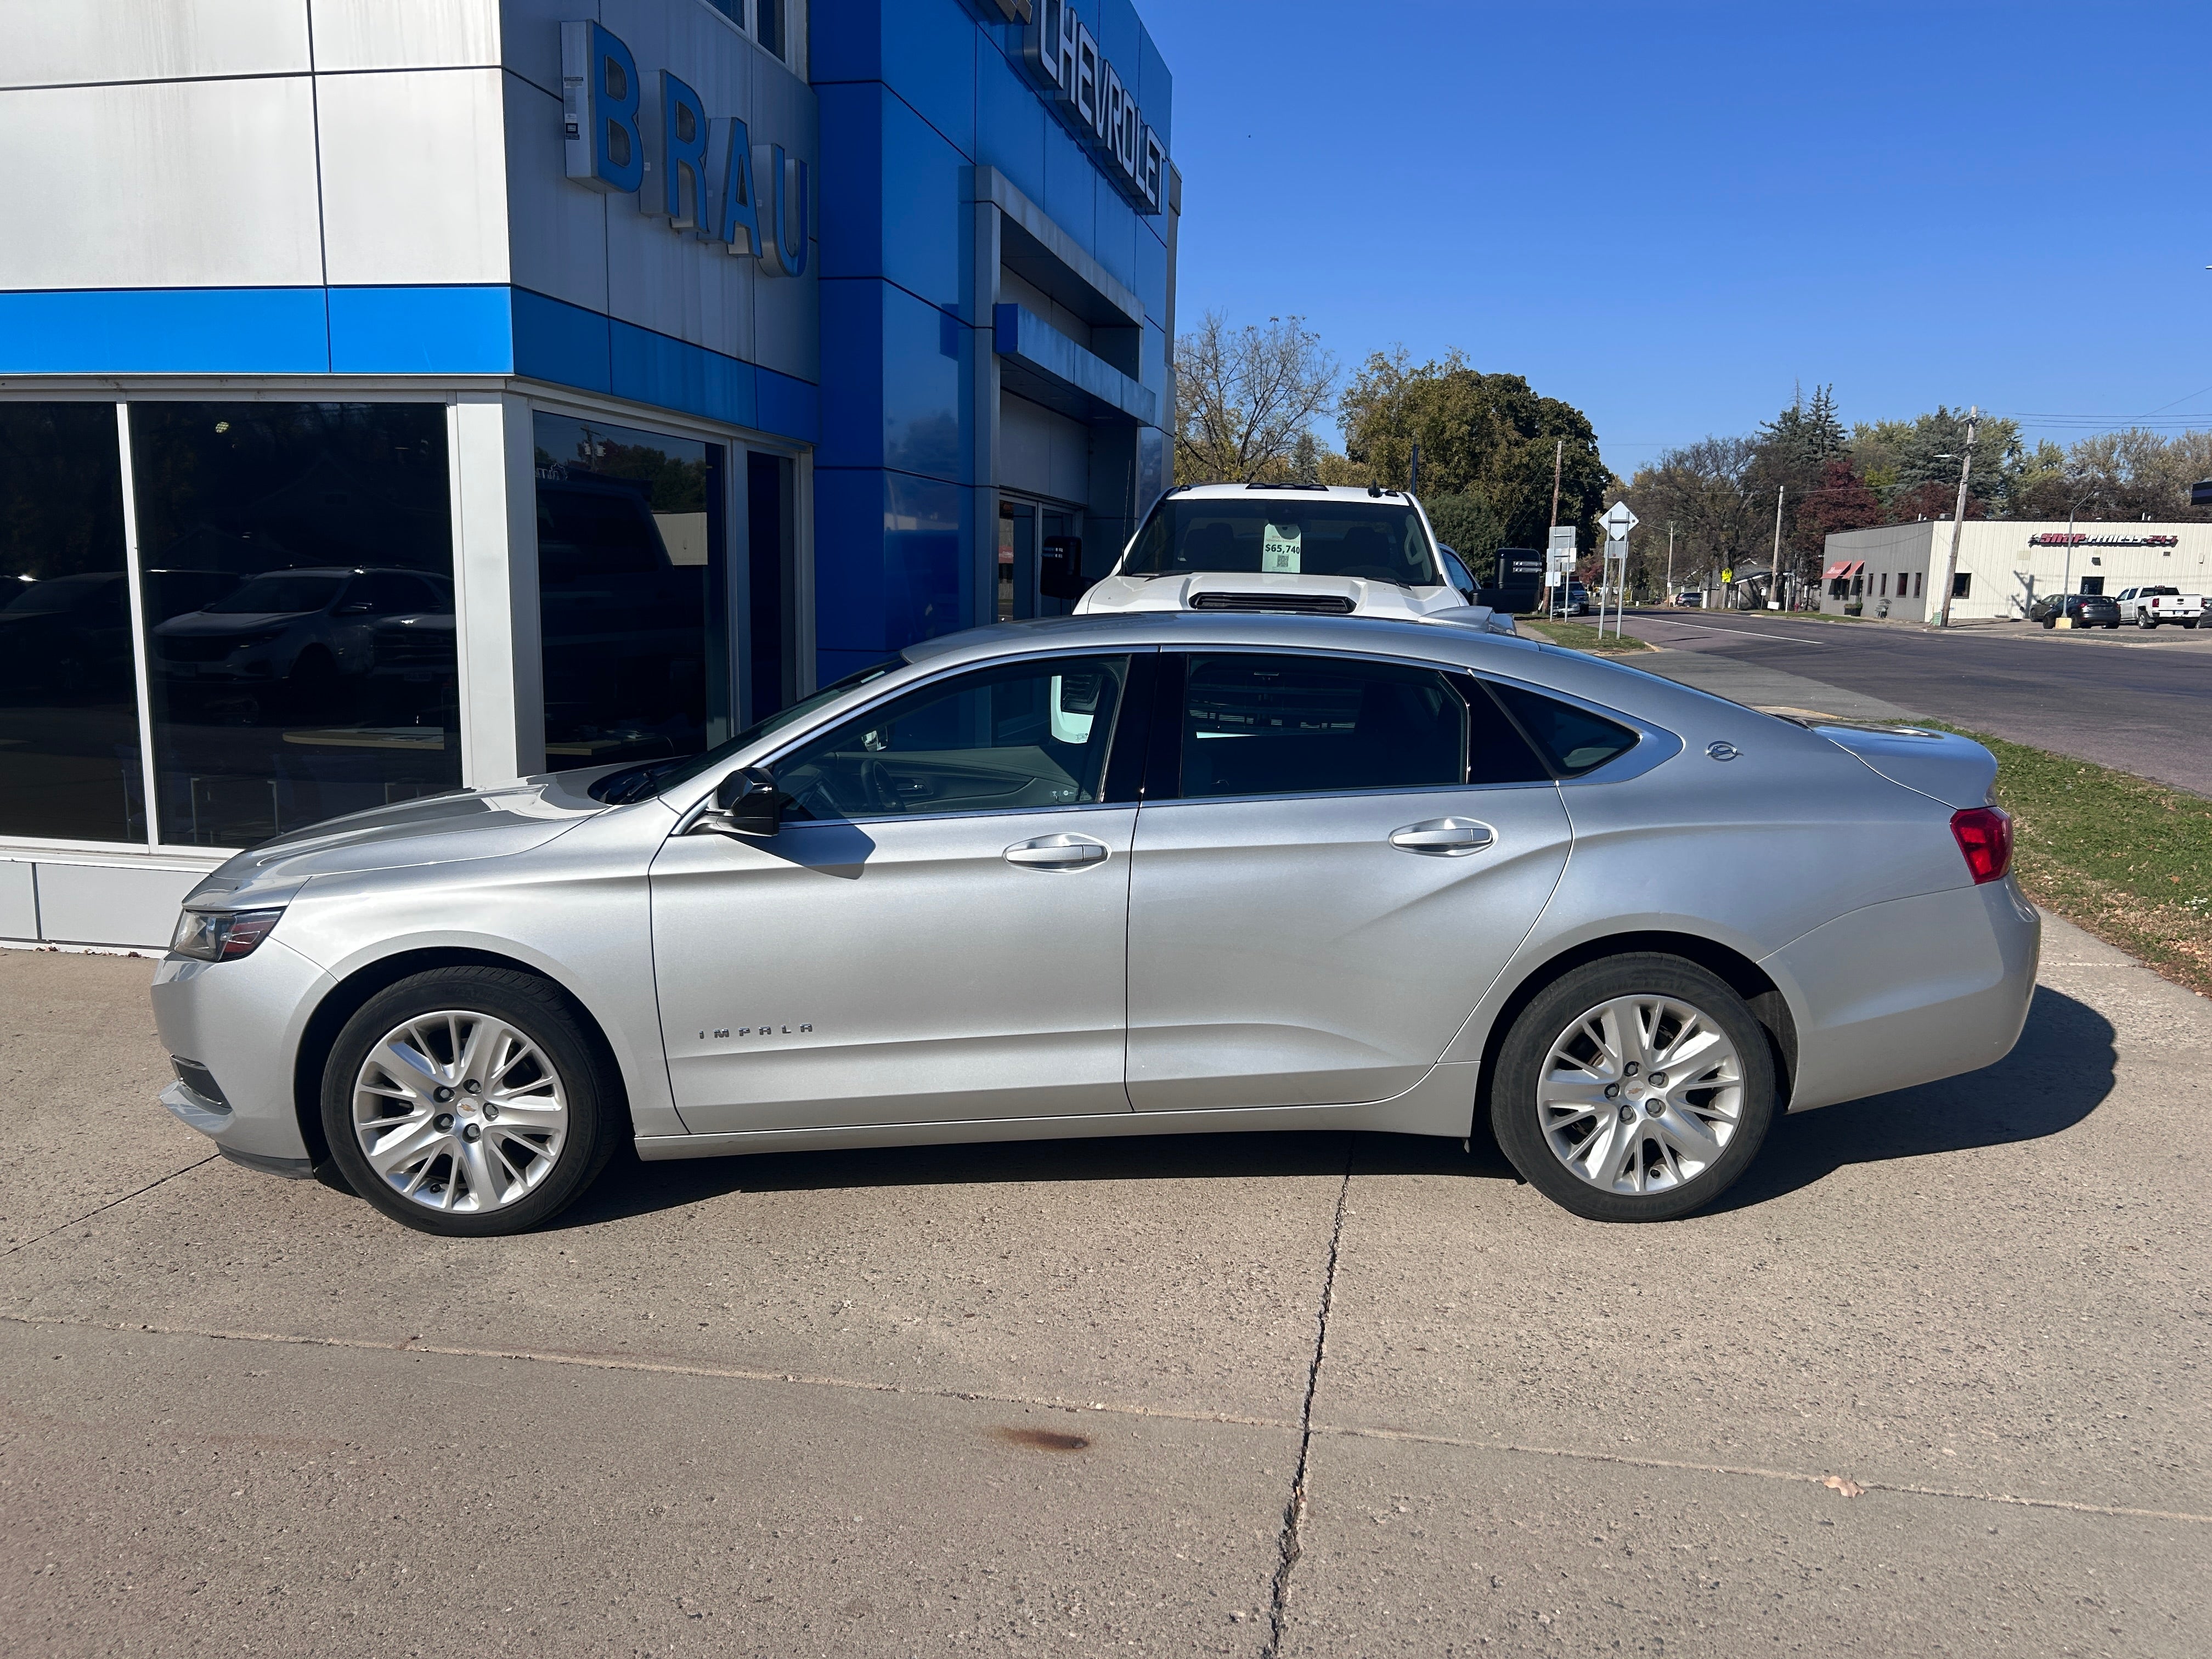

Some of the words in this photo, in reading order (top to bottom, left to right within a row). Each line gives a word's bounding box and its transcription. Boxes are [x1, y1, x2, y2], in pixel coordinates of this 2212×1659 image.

[587, 20, 809, 278] BRAU
[1037, 0, 1166, 215] CHEVROLET
[1265, 544, 1300, 554] $65,740
[699, 1022, 814, 1040] IMPALA
